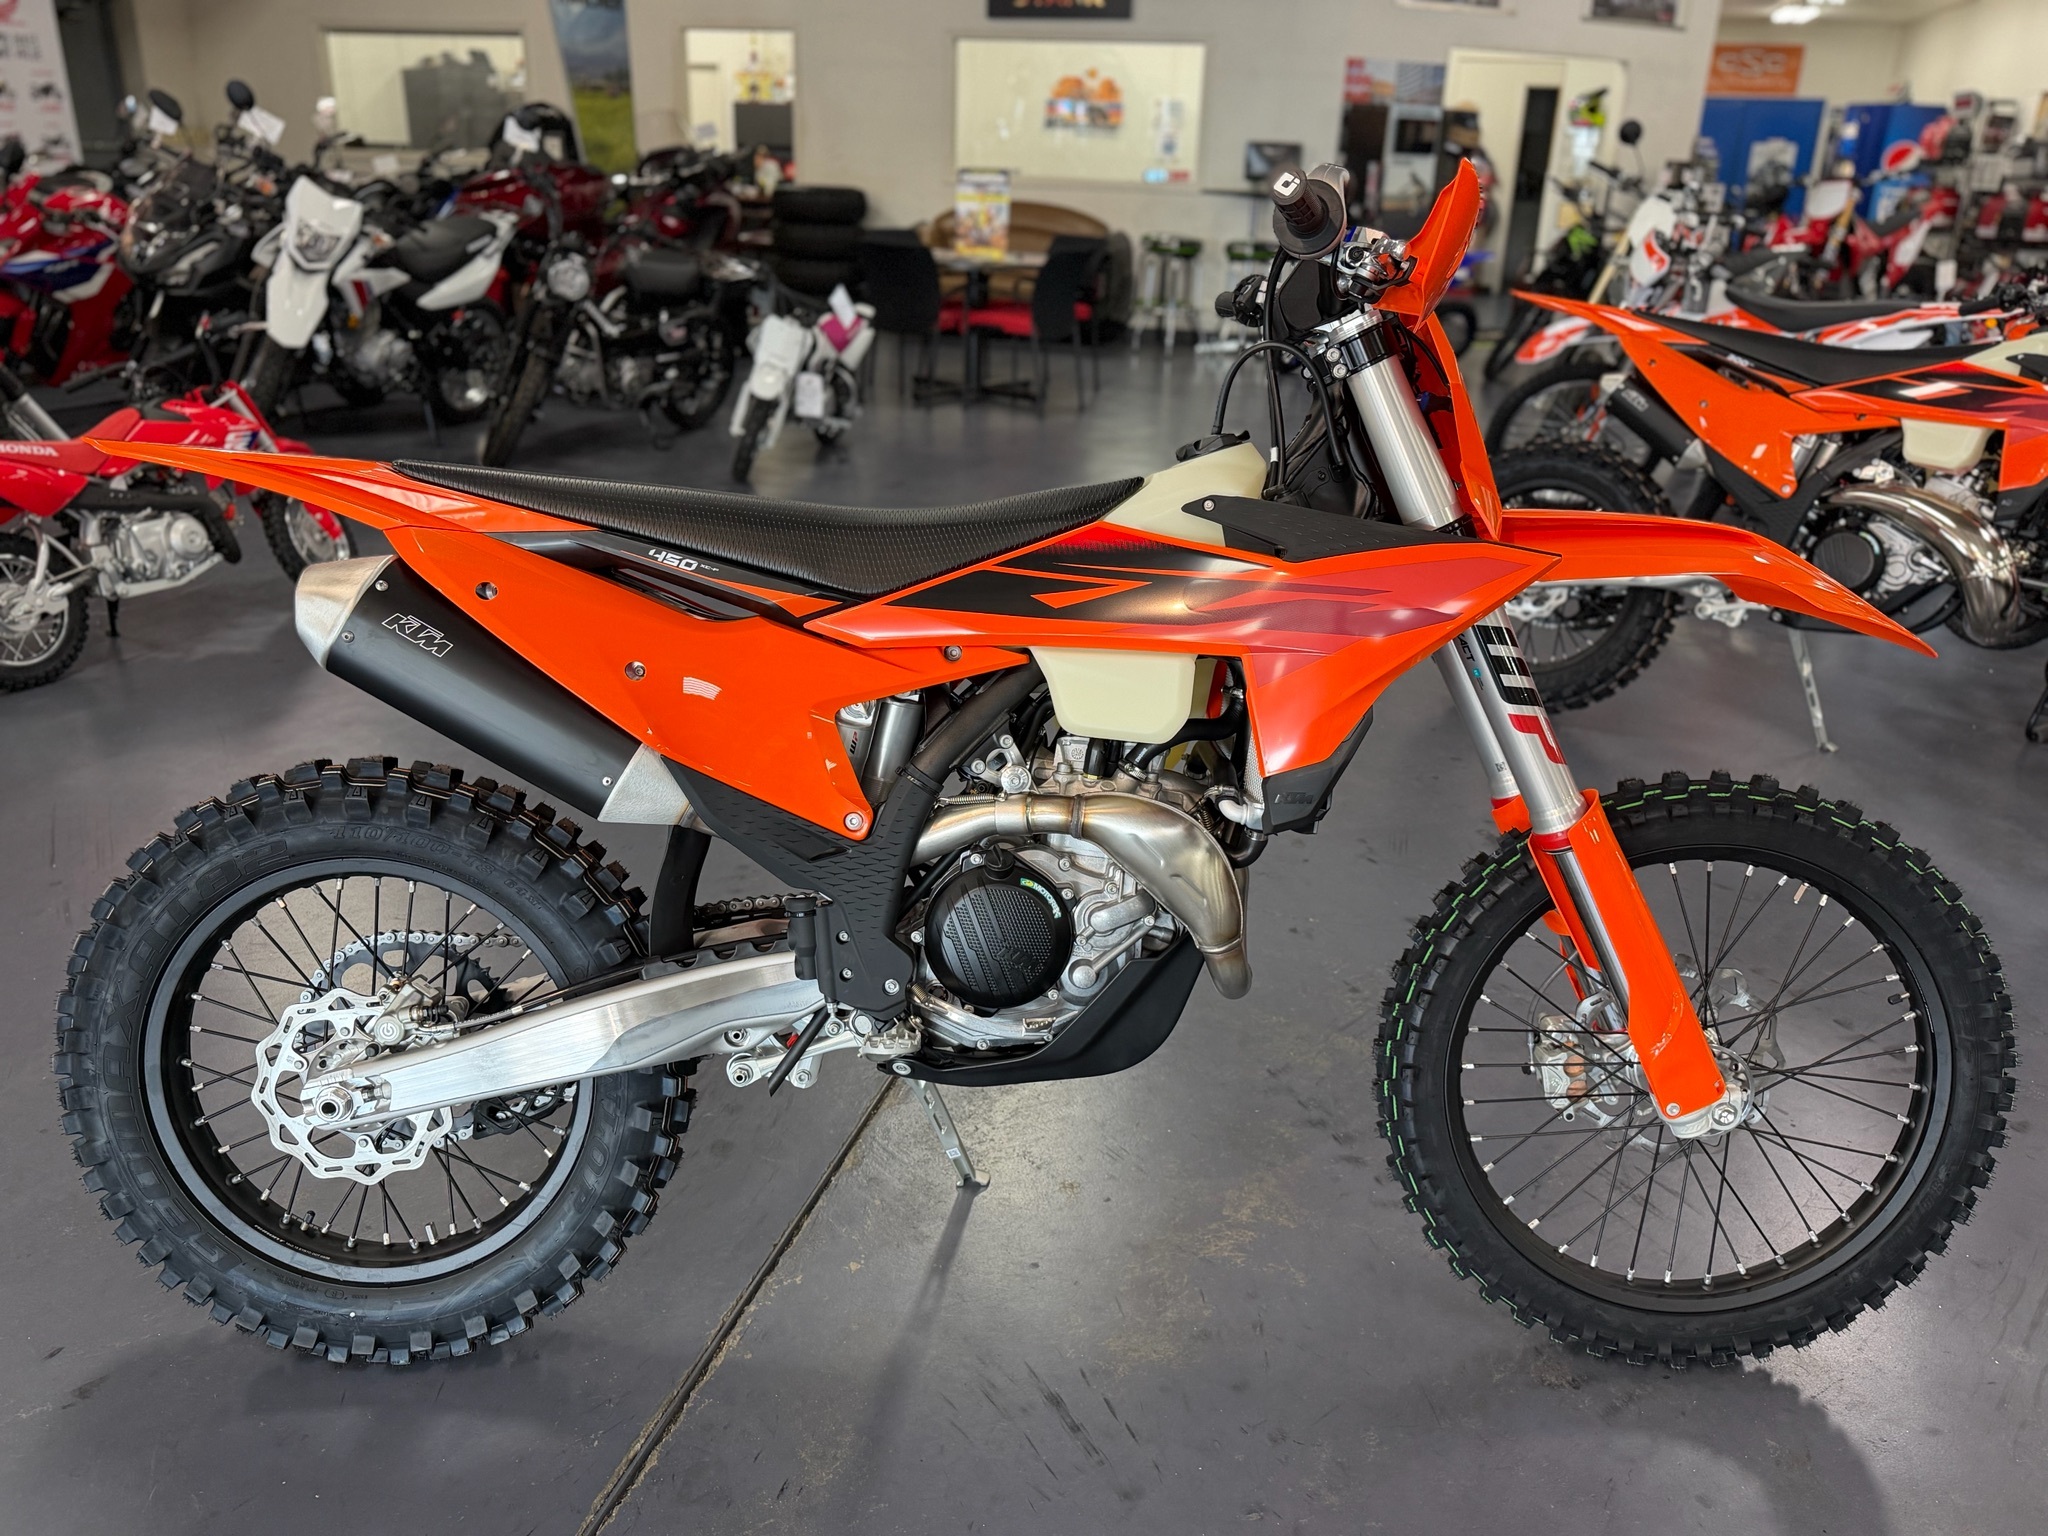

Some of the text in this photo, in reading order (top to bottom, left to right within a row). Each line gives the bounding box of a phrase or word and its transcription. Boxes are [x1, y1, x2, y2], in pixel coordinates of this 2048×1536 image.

[648, 549, 699, 571] 450
[381, 612, 454, 658] KTM
[331, 824, 497, 877] 110/100-18
[1033, 881, 1062, 919] MOTOREX
[103, 981, 244, 1275] GEOMAX
[572, 1073, 625, 1214] NLOP
